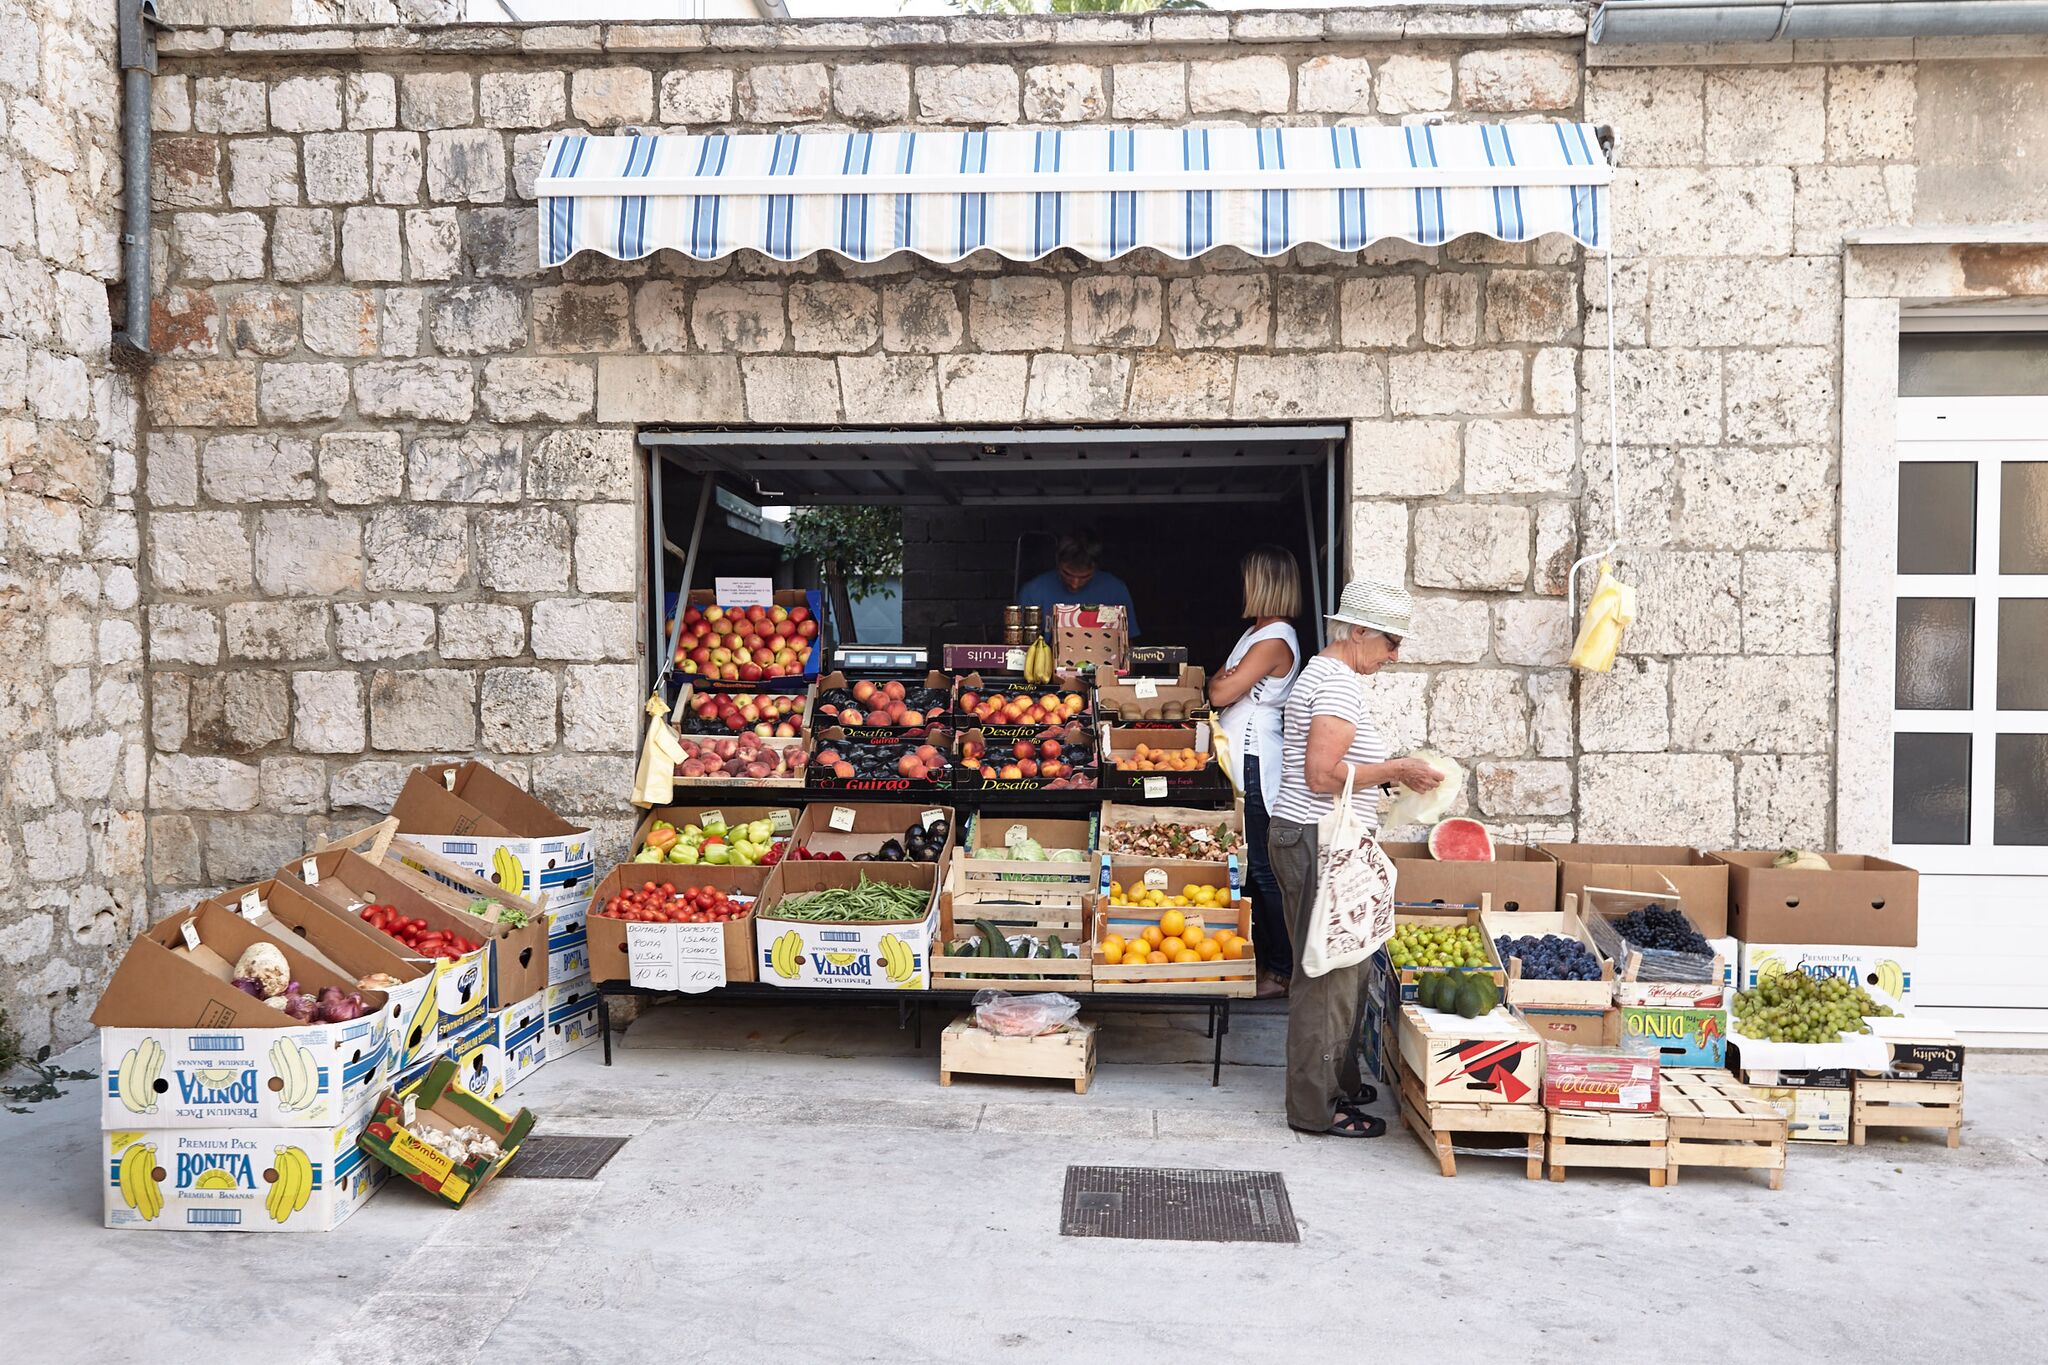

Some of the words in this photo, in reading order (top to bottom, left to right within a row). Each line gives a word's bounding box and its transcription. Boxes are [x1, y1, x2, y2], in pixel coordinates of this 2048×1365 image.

[1132, 651, 1165, 661] Quality
[1008, 683, 1037, 691] Desafio
[981, 726, 1035, 737] Desafio
[846, 778, 910, 790] Guirao
[981, 779, 1039, 790] Desafio
[679, 926, 720, 934] DOMESTIC
[1802, 953, 1839, 961] PREMIUM
[1842, 953, 1862, 961] PACK
[811, 953, 872, 976] BONITA
[635, 968, 652, 980] 10
[690, 970, 706, 981] 10
[1627, 1014, 1684, 1039] DINO
[1912, 1048, 1957, 1062] Quality
[173, 1069, 259, 1104] BONITA
[176, 1109, 203, 1118] PACK
[206, 1109, 258, 1118] PREMIUM
[178, 1137, 227, 1148] PREMIUM
[231, 1138, 257, 1149] PACK
[175, 1153, 258, 1189] BONITA
[178, 1191, 213, 1199] PREMIUM
[219, 1191, 254, 1199] BANANAS
